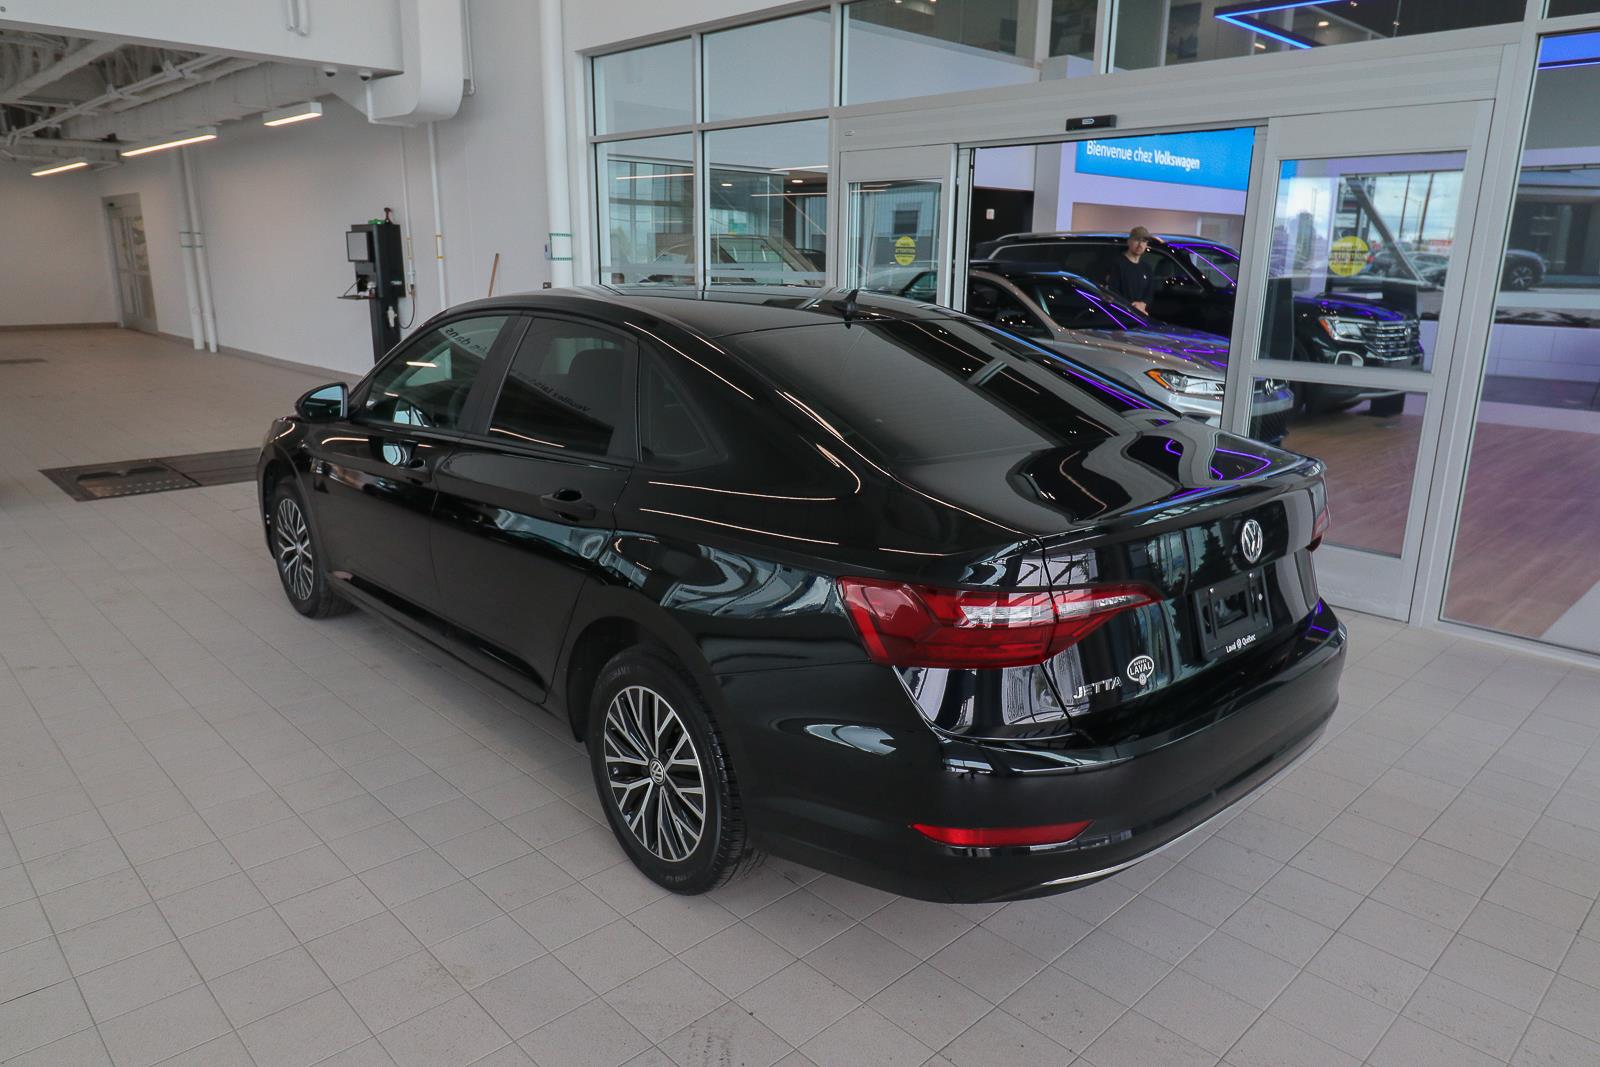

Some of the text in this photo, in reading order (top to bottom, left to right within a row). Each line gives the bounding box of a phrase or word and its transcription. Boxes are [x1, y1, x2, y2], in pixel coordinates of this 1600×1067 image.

[1086, 140, 1201, 172] Bienvenue chez Volkswagen
[1129, 661, 1152, 676] LAVAL
[1073, 676, 1122, 699] JETTA
